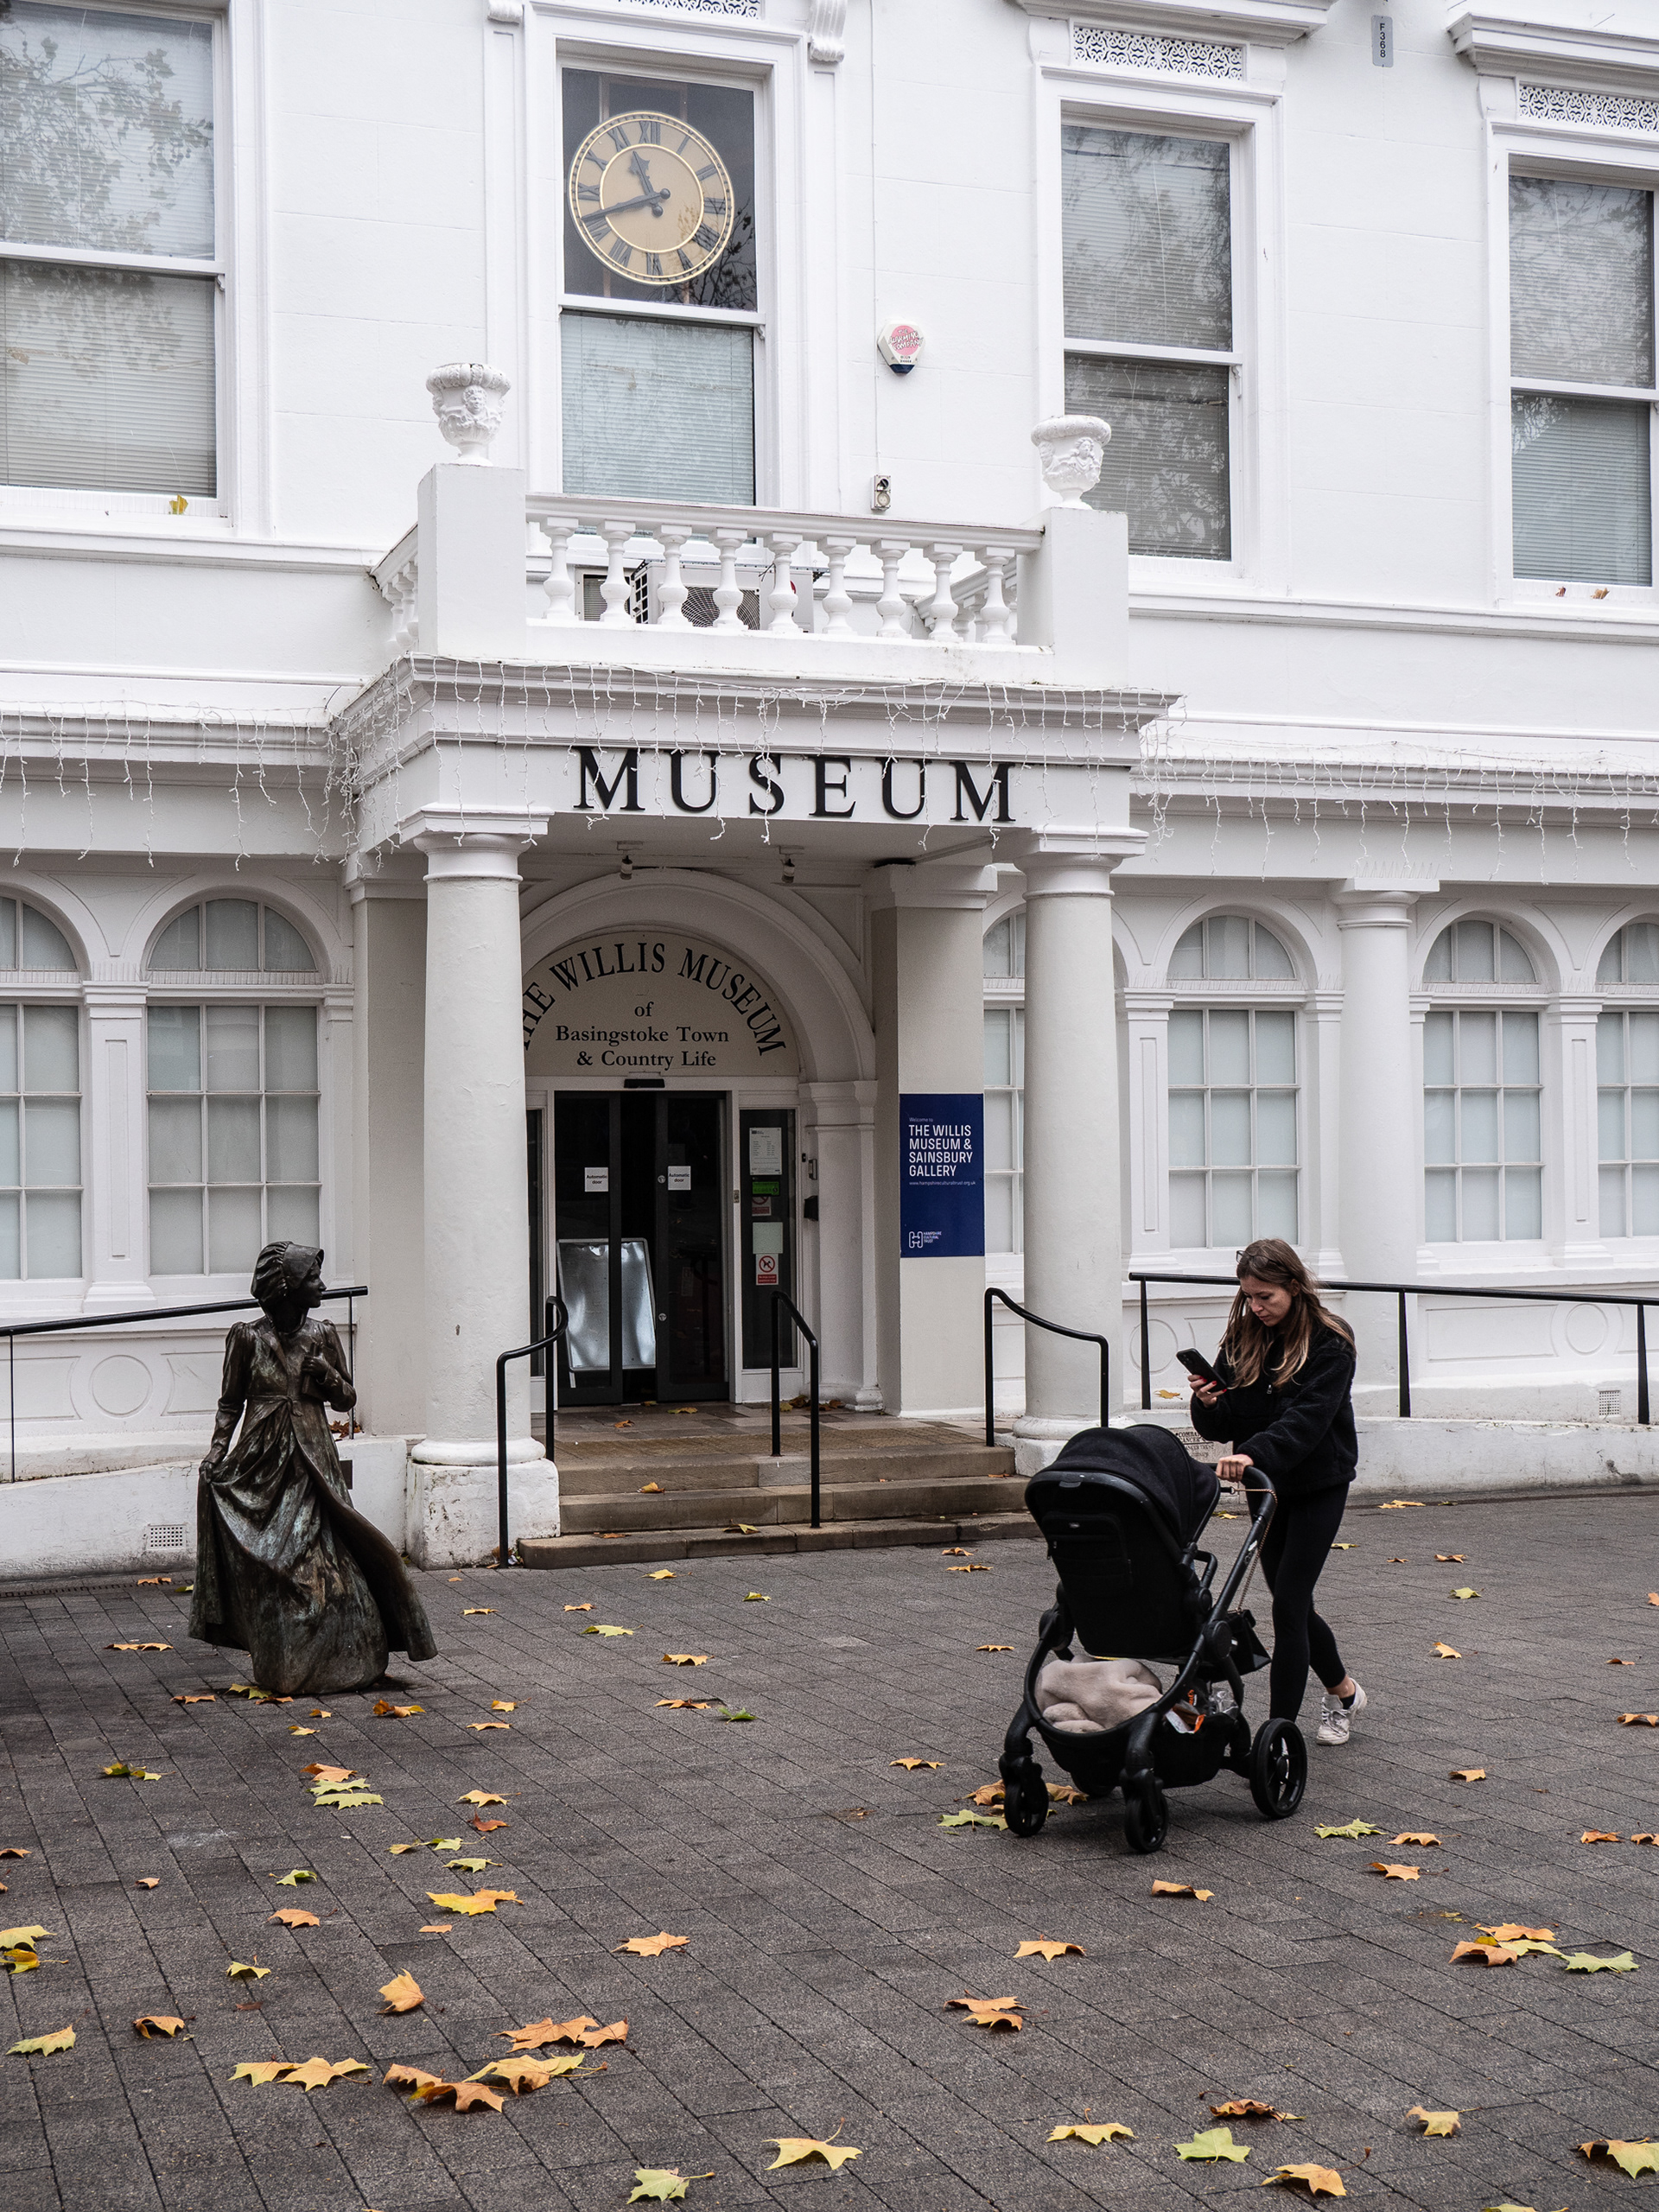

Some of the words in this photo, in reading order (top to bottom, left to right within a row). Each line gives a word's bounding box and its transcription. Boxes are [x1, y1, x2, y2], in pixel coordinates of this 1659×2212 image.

[573, 747, 1016, 822] MUSEUM
[522, 982, 556, 1052] HE
[548, 942, 665, 992] WILLIS
[677, 947, 786, 1057] MUSEUM
[634, 1001, 654, 1017] of
[555, 1025, 669, 1047] Basingstoke
[676, 1026, 729, 1042] Town
[576, 1051, 594, 1066] &
[601, 1050, 674, 1071] Country
[681, 1051, 716, 1067] Life
[908, 1124, 930, 1136] THE
[932, 1124, 971, 1137] WILLIS
[909, 1138, 961, 1150] MUSEUM
[963, 1138, 972, 1150] &
[908, 1151, 973, 1163] SAINSBURY
[909, 1165, 957, 1177] GALLERY
